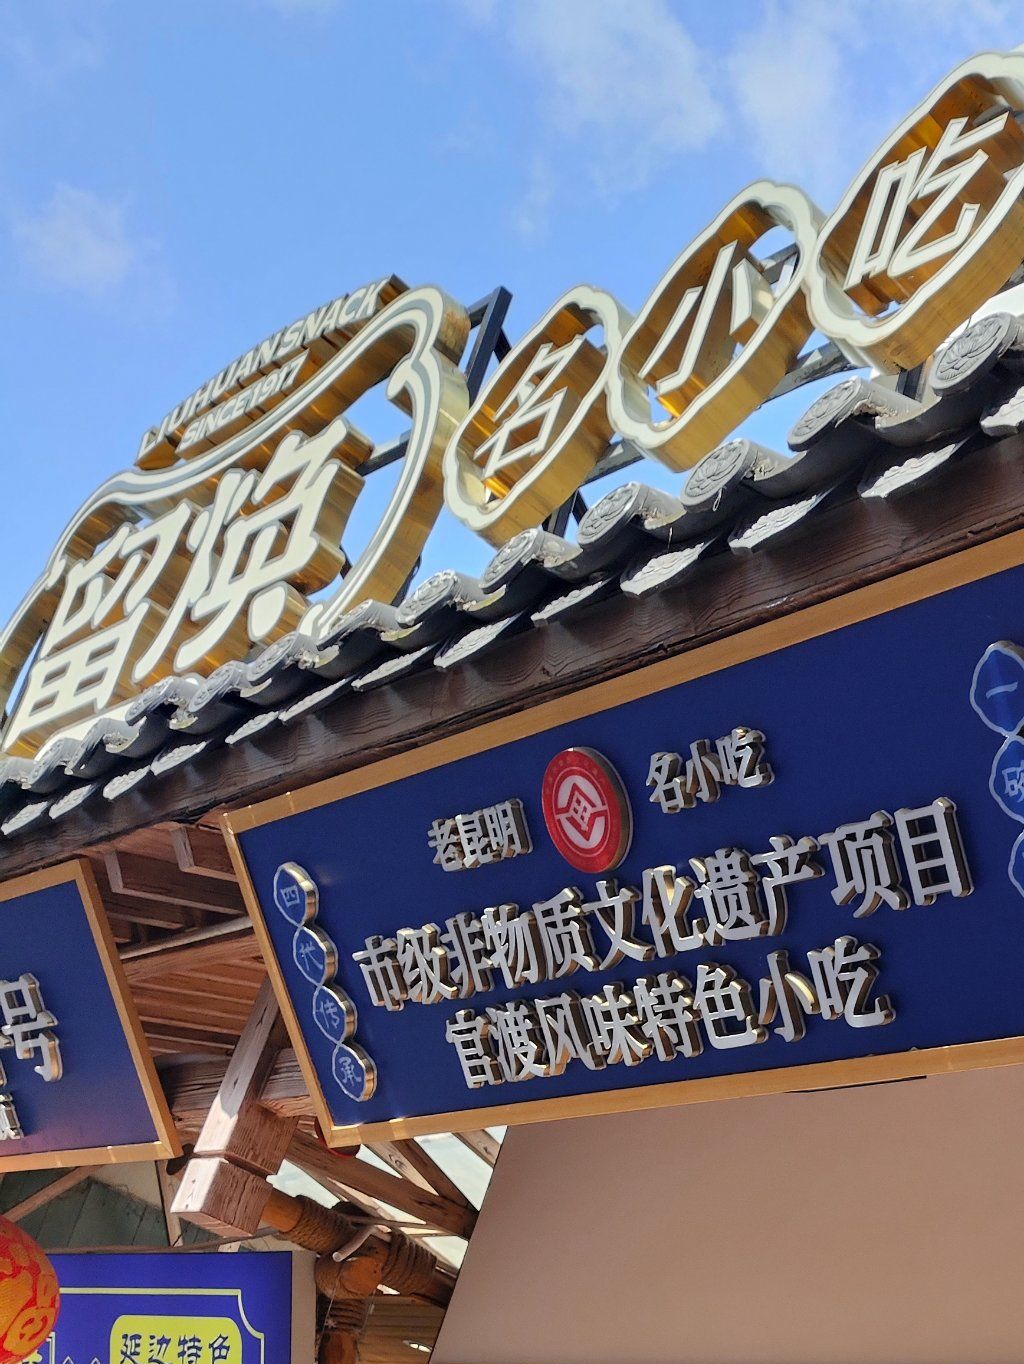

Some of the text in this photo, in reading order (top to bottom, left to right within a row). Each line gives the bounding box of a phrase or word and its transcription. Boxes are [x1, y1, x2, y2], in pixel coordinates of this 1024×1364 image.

[137, 278, 392, 457] LIUHUAN SNACK
[181, 350, 310, 446] SINCE 1917
[3, 418, 352, 753] 留焕
[427, 798, 534, 872] 老昆明
[646, 726, 775, 814] 名小吃
[280, 884, 363, 1087] 四代传承
[352, 797, 974, 1011] 市级非物质文化遗产项目
[445, 935, 898, 1090] 官渡风味特色小吃
